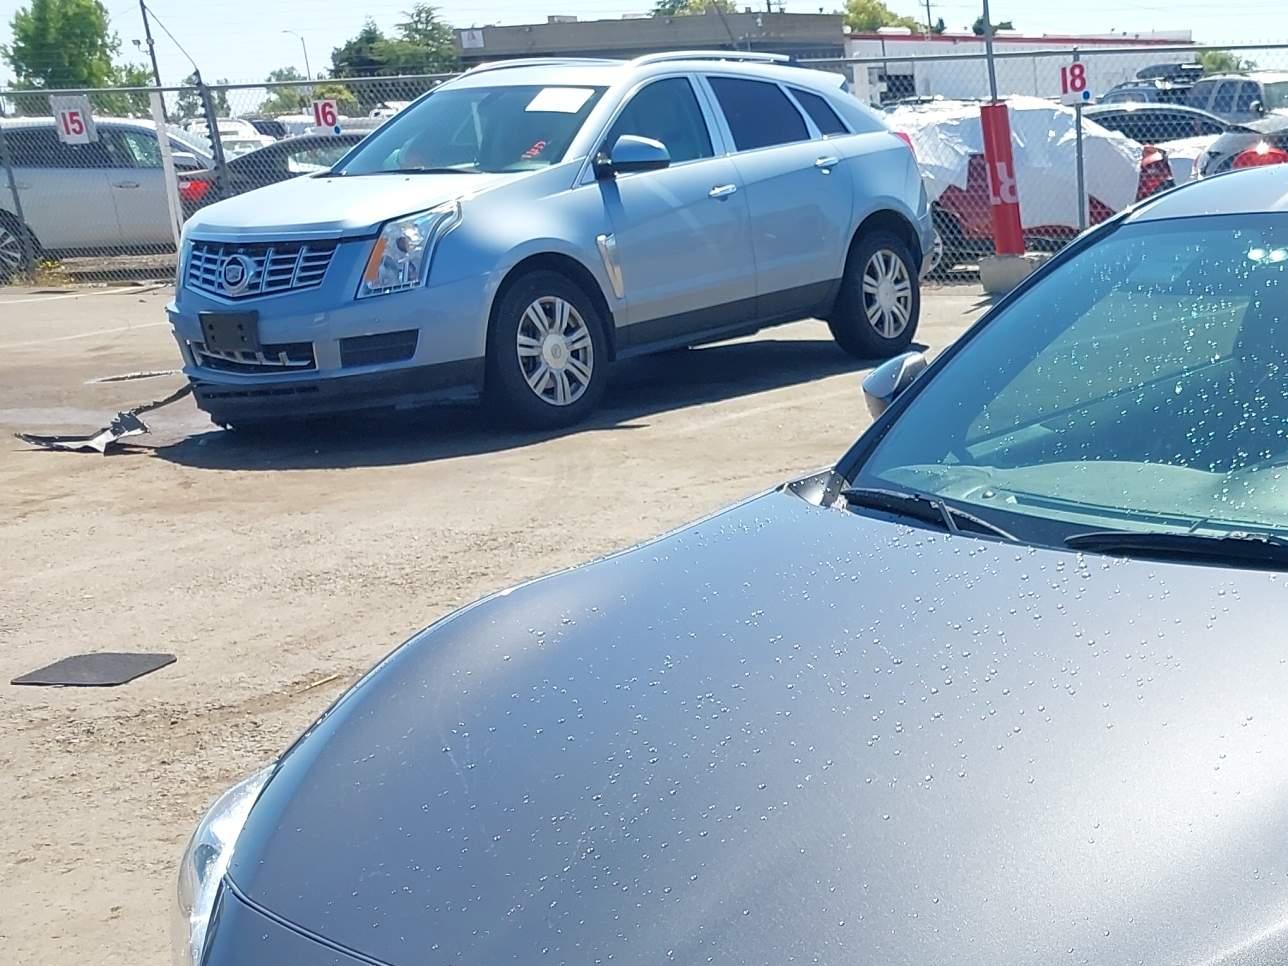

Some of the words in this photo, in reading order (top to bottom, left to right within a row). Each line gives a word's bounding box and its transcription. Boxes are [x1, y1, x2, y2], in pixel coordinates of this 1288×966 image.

[1060, 63, 1087, 95] 18
[60, 111, 84, 136] 15
[313, 101, 337, 127] 16
